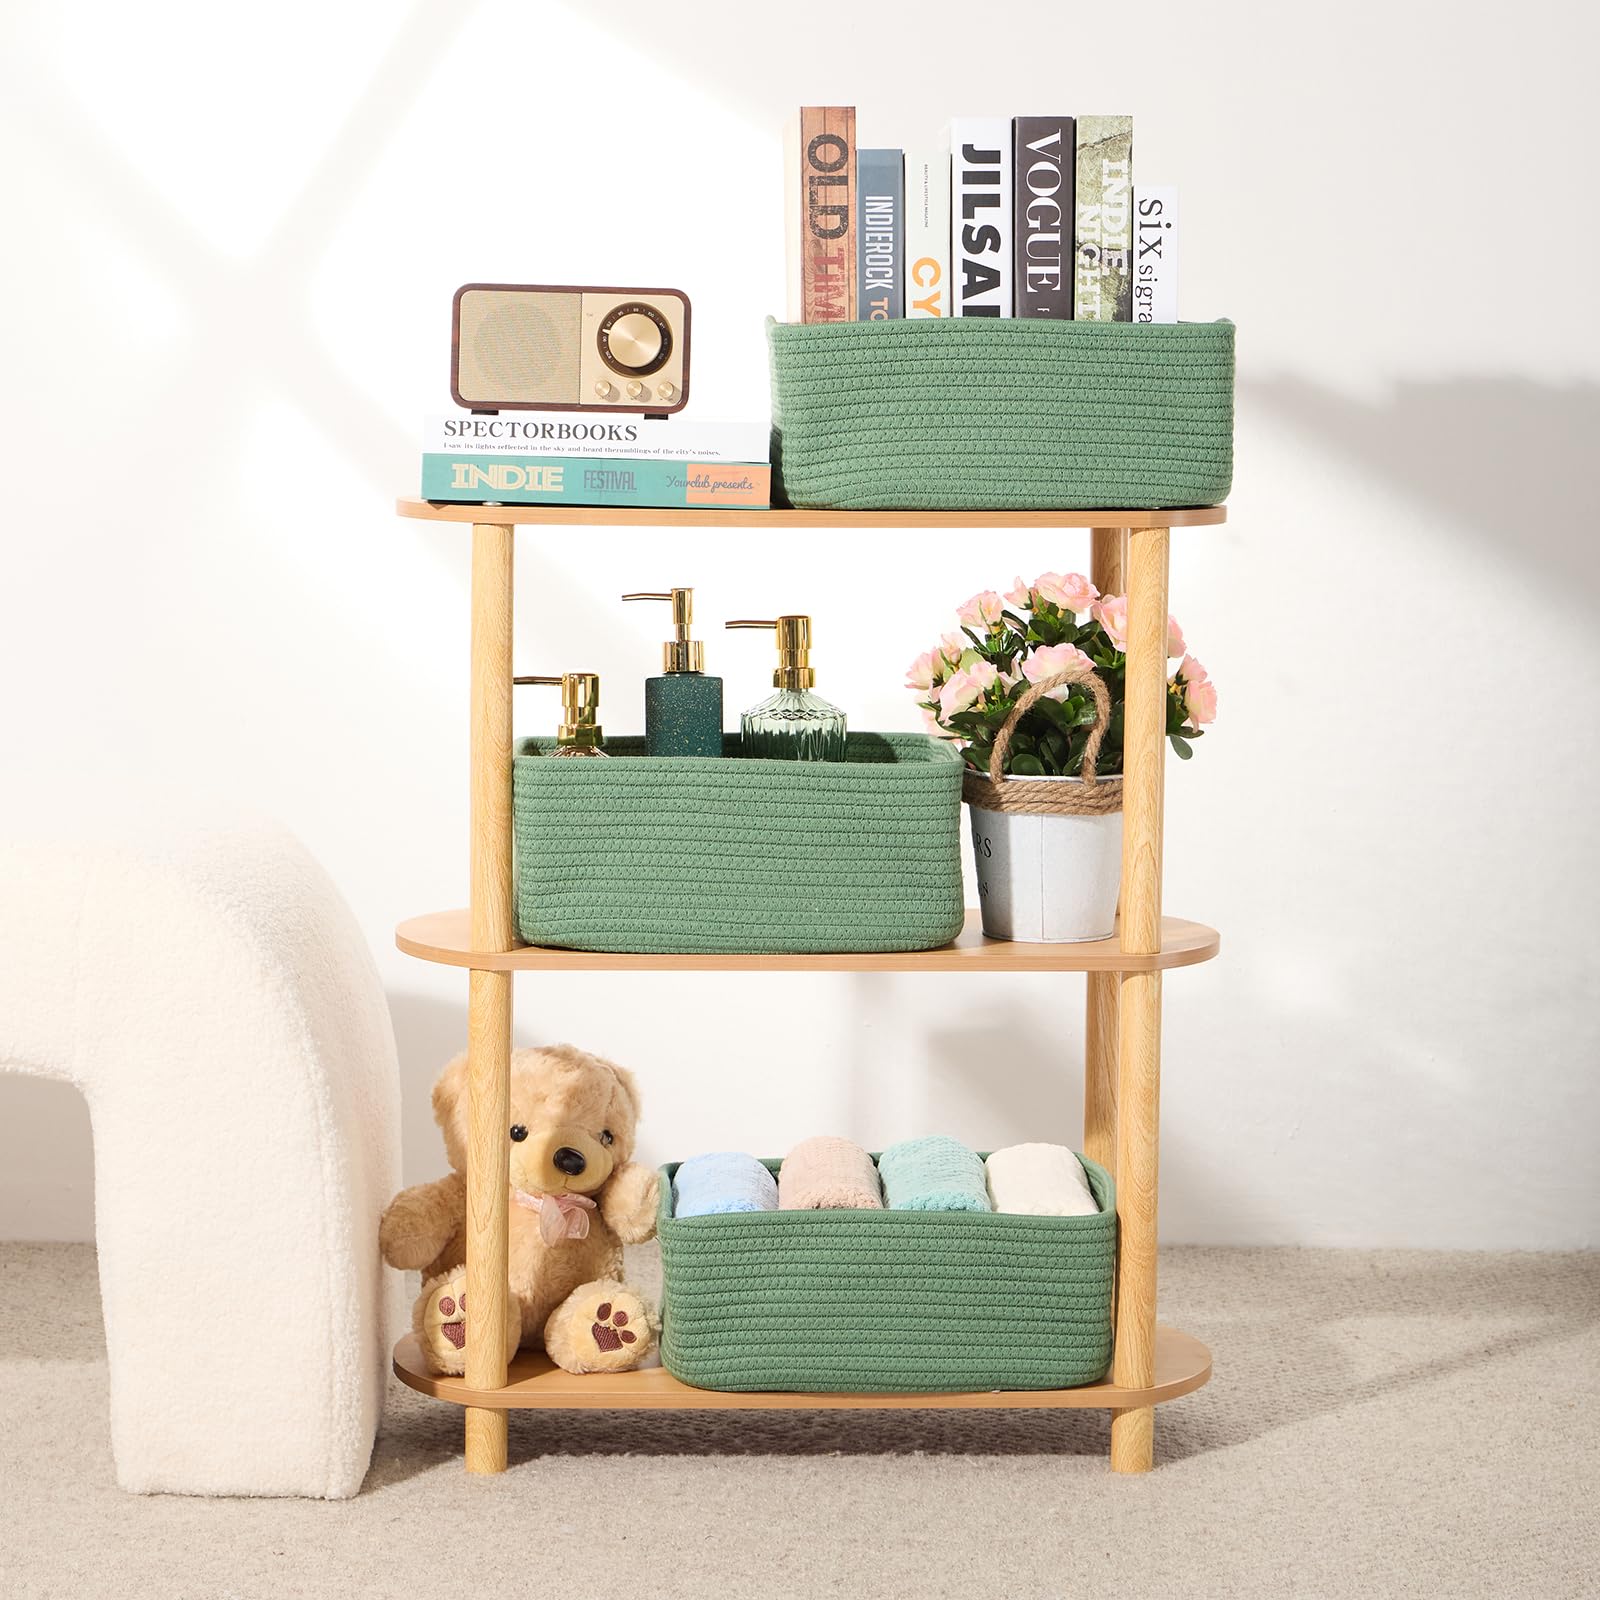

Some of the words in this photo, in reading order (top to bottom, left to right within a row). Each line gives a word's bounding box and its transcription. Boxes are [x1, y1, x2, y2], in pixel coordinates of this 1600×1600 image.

[808, 134, 848, 240] OLD
[1025, 128, 1062, 293] VOGUE
[1101, 159, 1128, 276] INDIE
[865, 196, 894, 290] INDIEROCK
[1078, 203, 1101, 320] NIGHT
[814, 248, 846, 322] TIM
[912, 257, 941, 317] CY
[443, 420, 639, 441] SPECTORBOOKS
[451, 463, 564, 492] INDIE
[583, 470, 637, 490] FESTIVAL
[711, 476, 754, 493] presents
